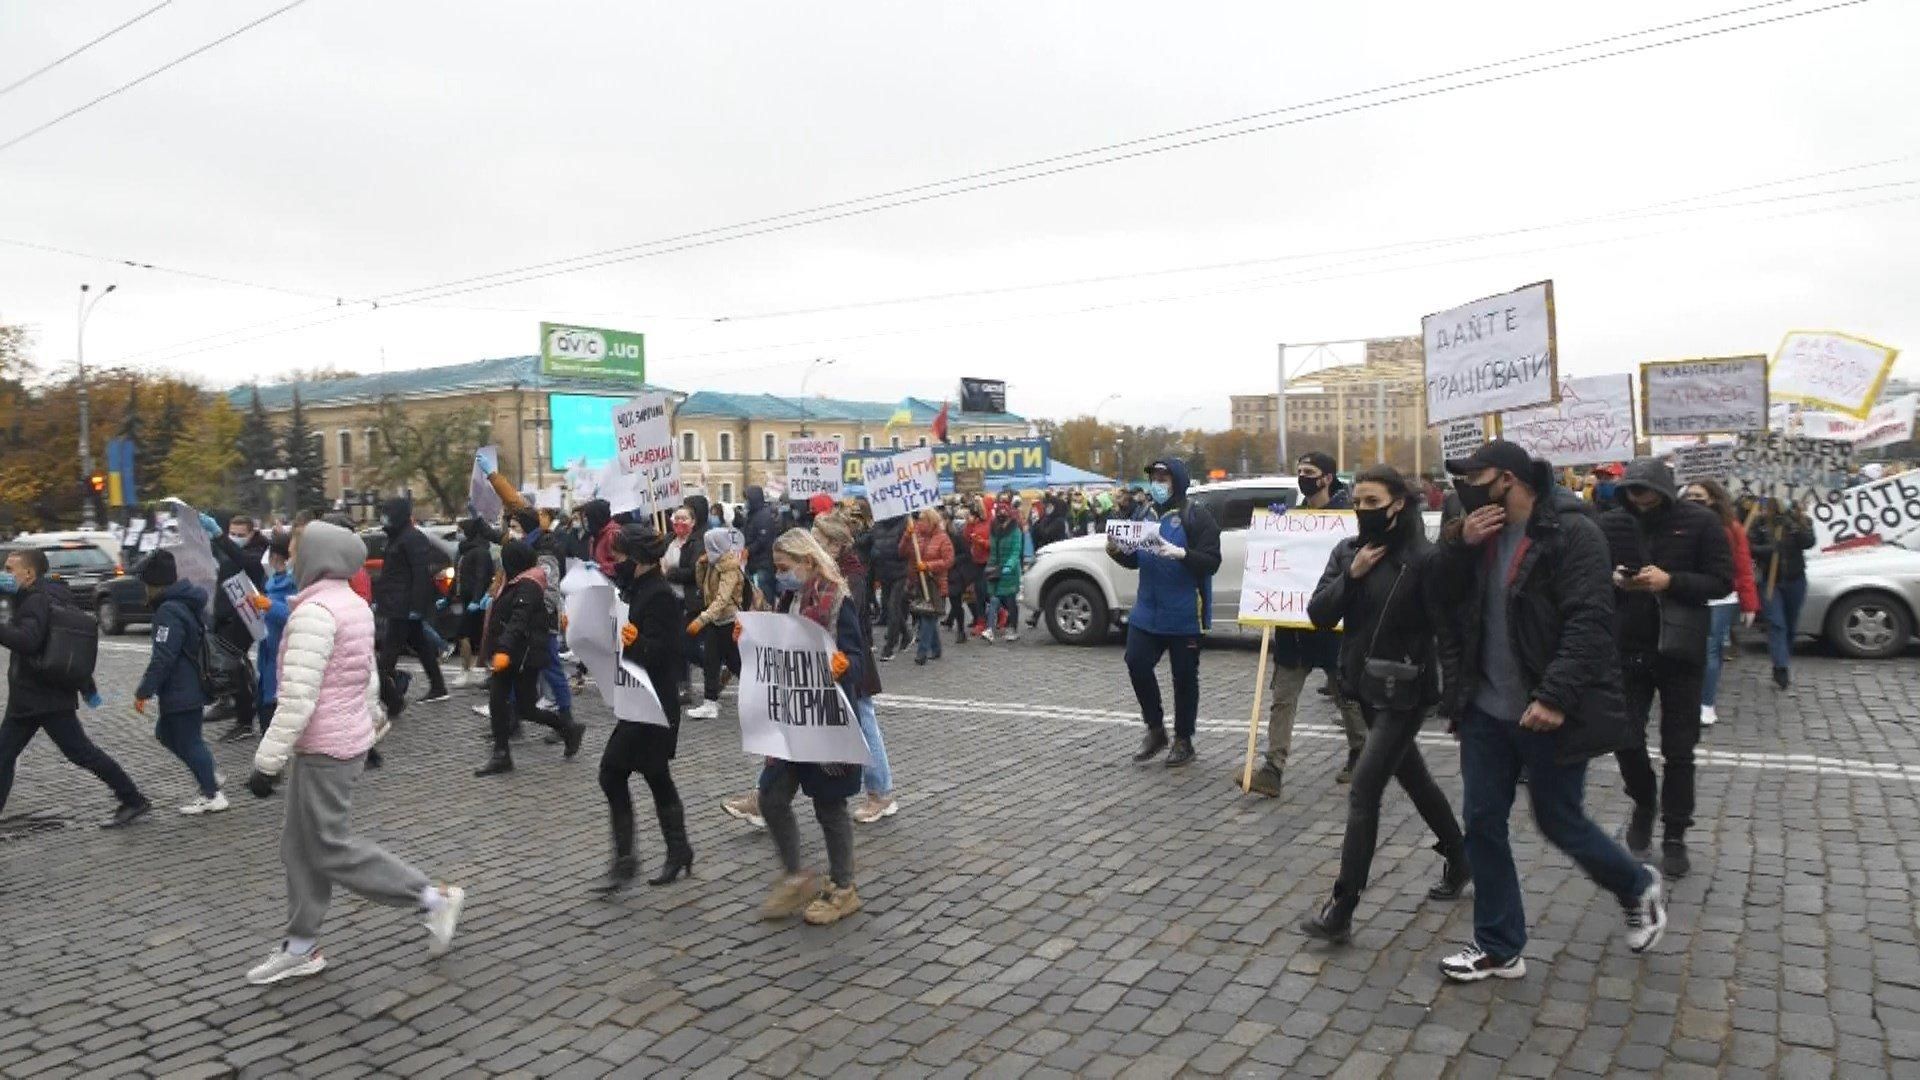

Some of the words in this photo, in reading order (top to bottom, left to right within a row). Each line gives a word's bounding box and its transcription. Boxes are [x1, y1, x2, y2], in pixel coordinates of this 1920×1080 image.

[1436, 306, 1519, 350] ДАЙТЕ
[1428, 351, 1549, 402] ПРАЦЮВАТИ
[865, 456, 894, 482] НАШІ
[896, 456, 938, 482] ДІТИ
[934, 446, 1042, 474] РЕМОГИ
[870, 479, 921, 504] ХОЧУТЬ
[1815, 480, 1919, 522] ОТАТЬ
[1264, 514, 1347, 532] РОБОТА
[1253, 590, 1309, 613] ЖИТ
